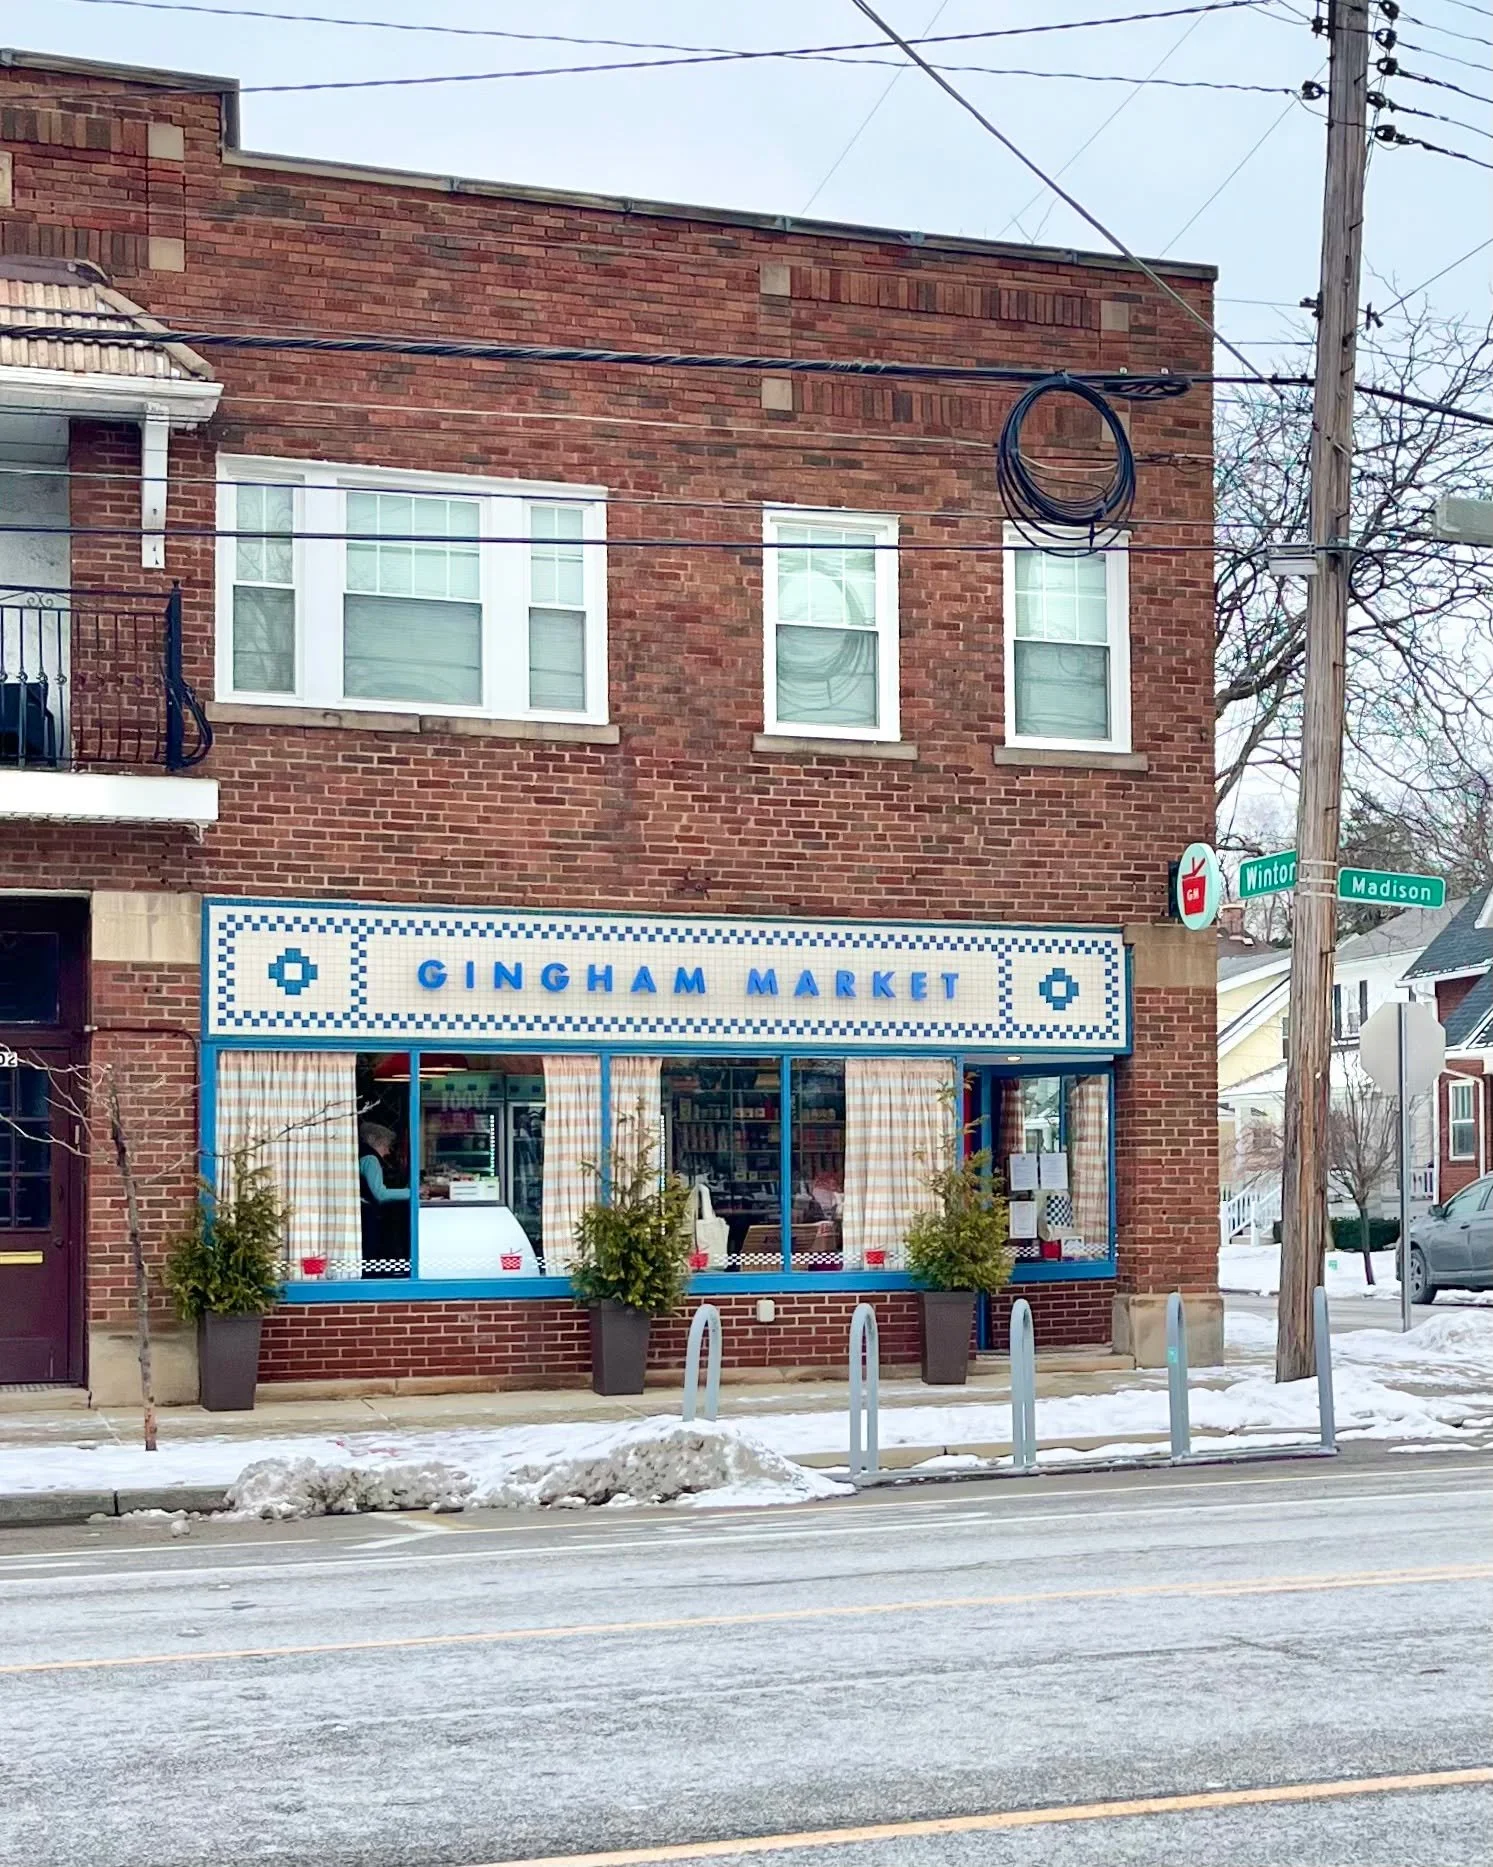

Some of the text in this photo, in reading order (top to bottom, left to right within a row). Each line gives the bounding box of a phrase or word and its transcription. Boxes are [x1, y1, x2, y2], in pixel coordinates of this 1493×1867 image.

[1352, 876, 1431, 901] Madison
[417, 959, 959, 999] GINGHAM MARKET
